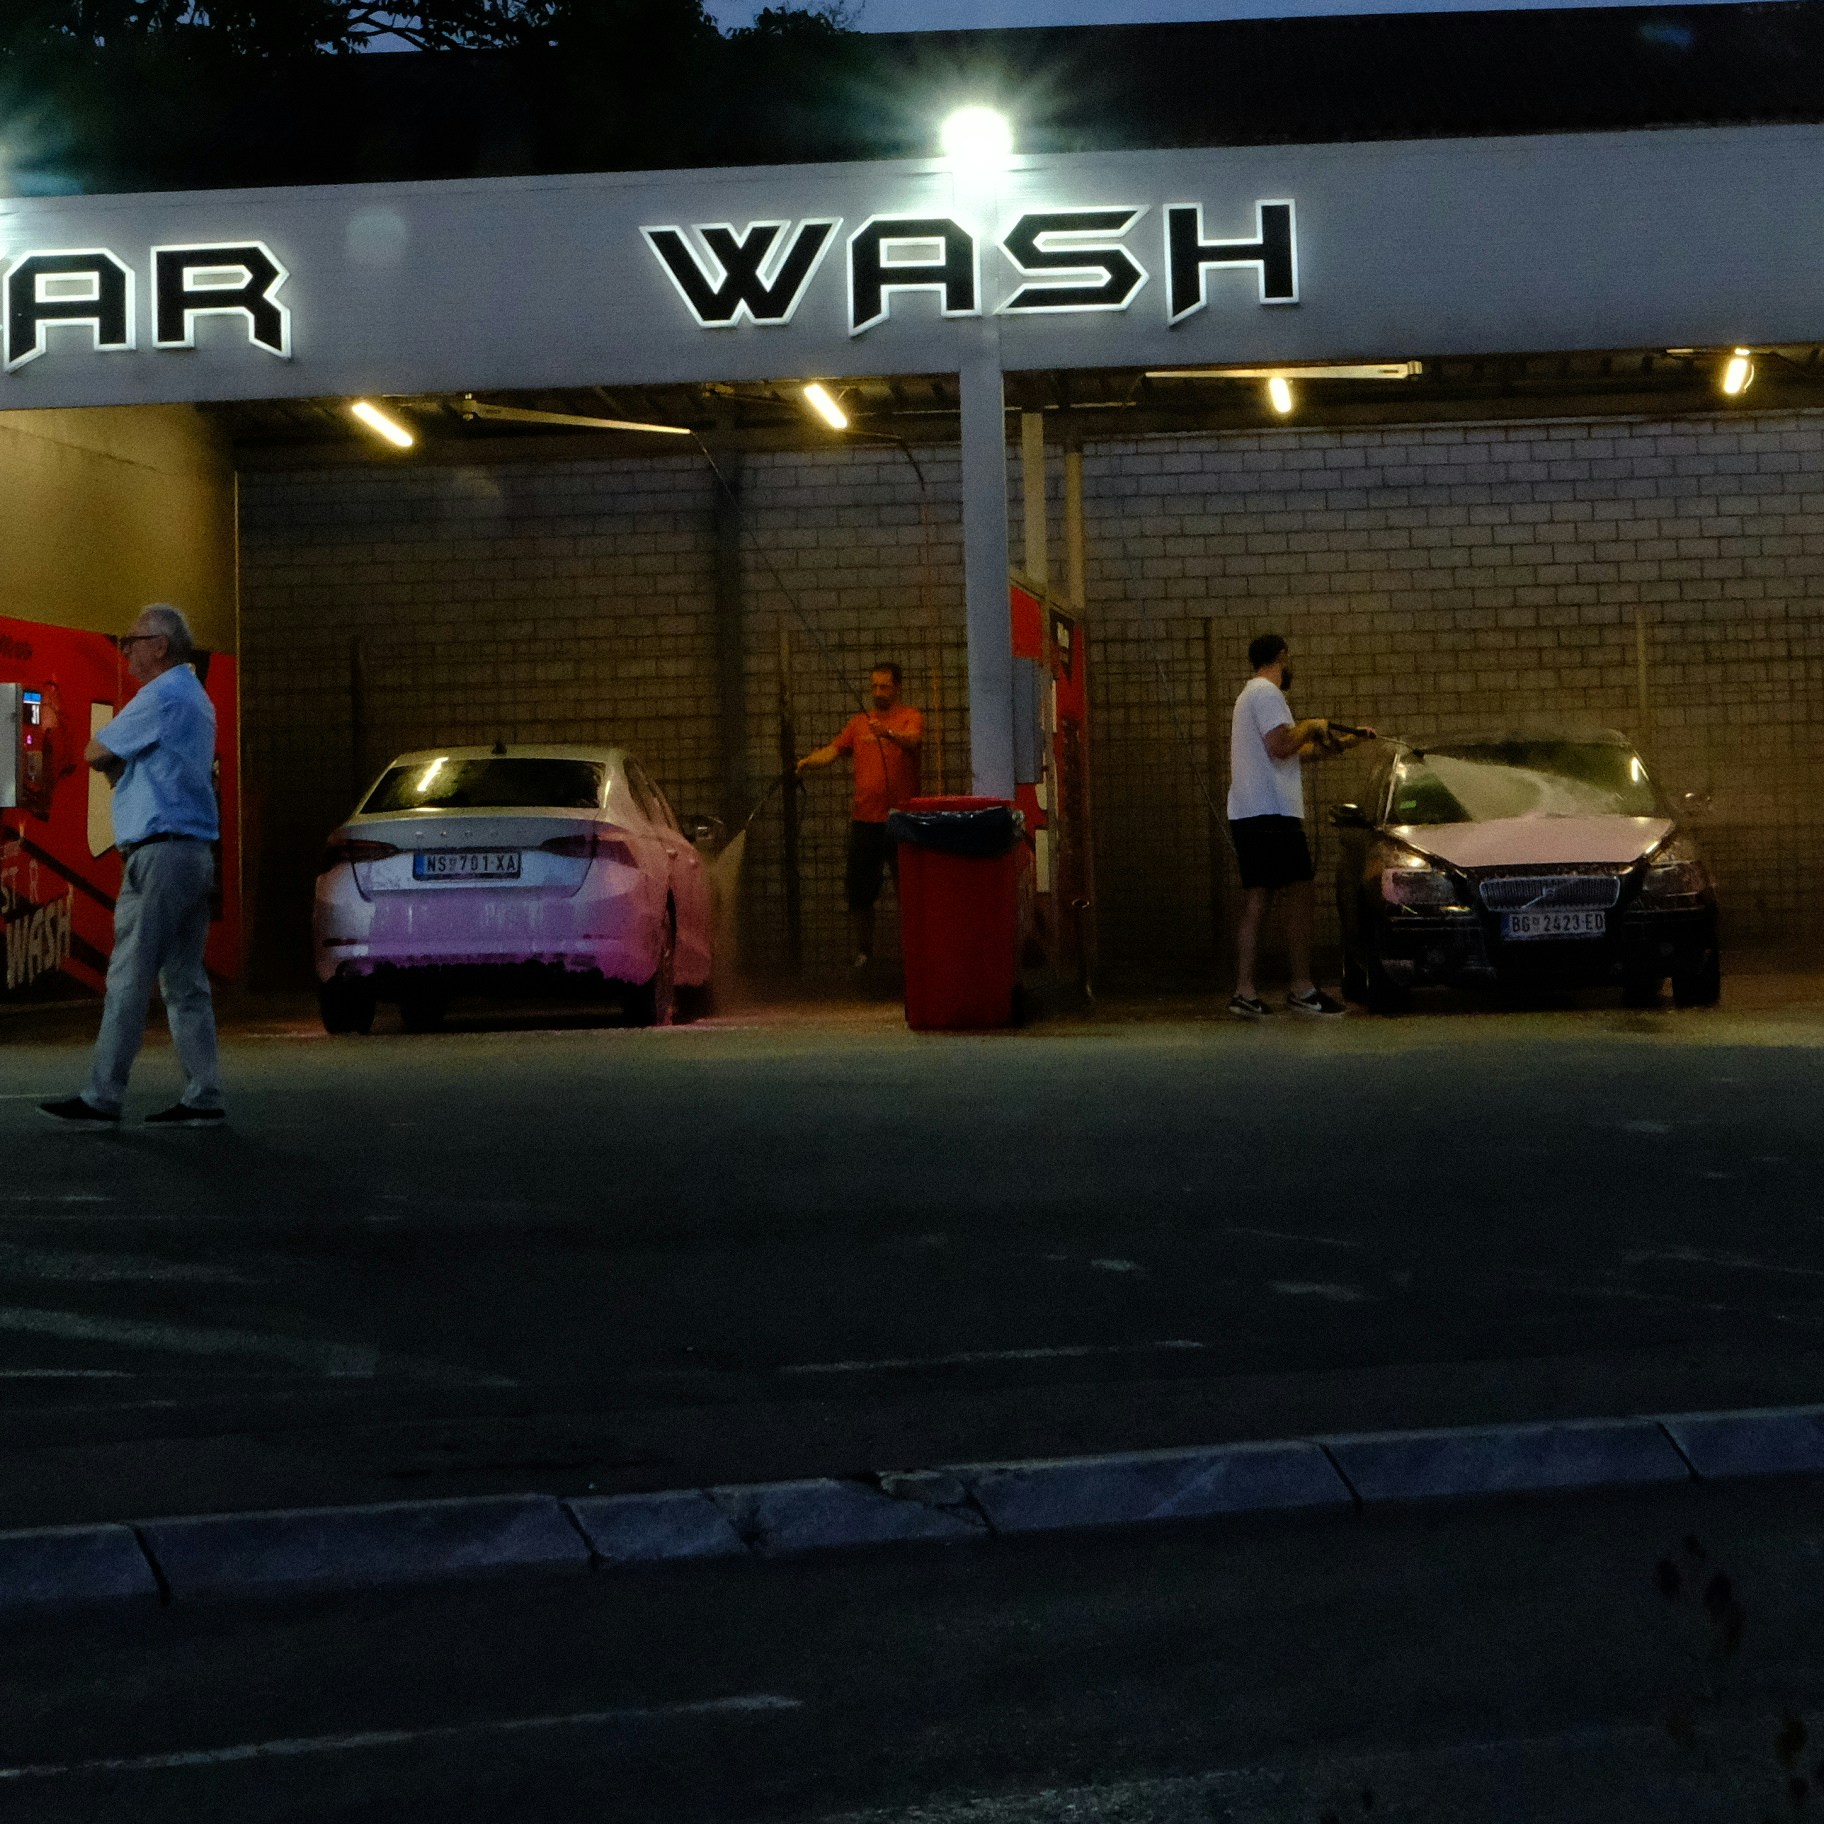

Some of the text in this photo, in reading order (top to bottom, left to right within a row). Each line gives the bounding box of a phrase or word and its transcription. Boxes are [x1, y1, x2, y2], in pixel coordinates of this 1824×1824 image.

[639, 199, 1299, 338] WASH
[427, 855, 446, 872] NS
[6, 882, 73, 990] WASH
